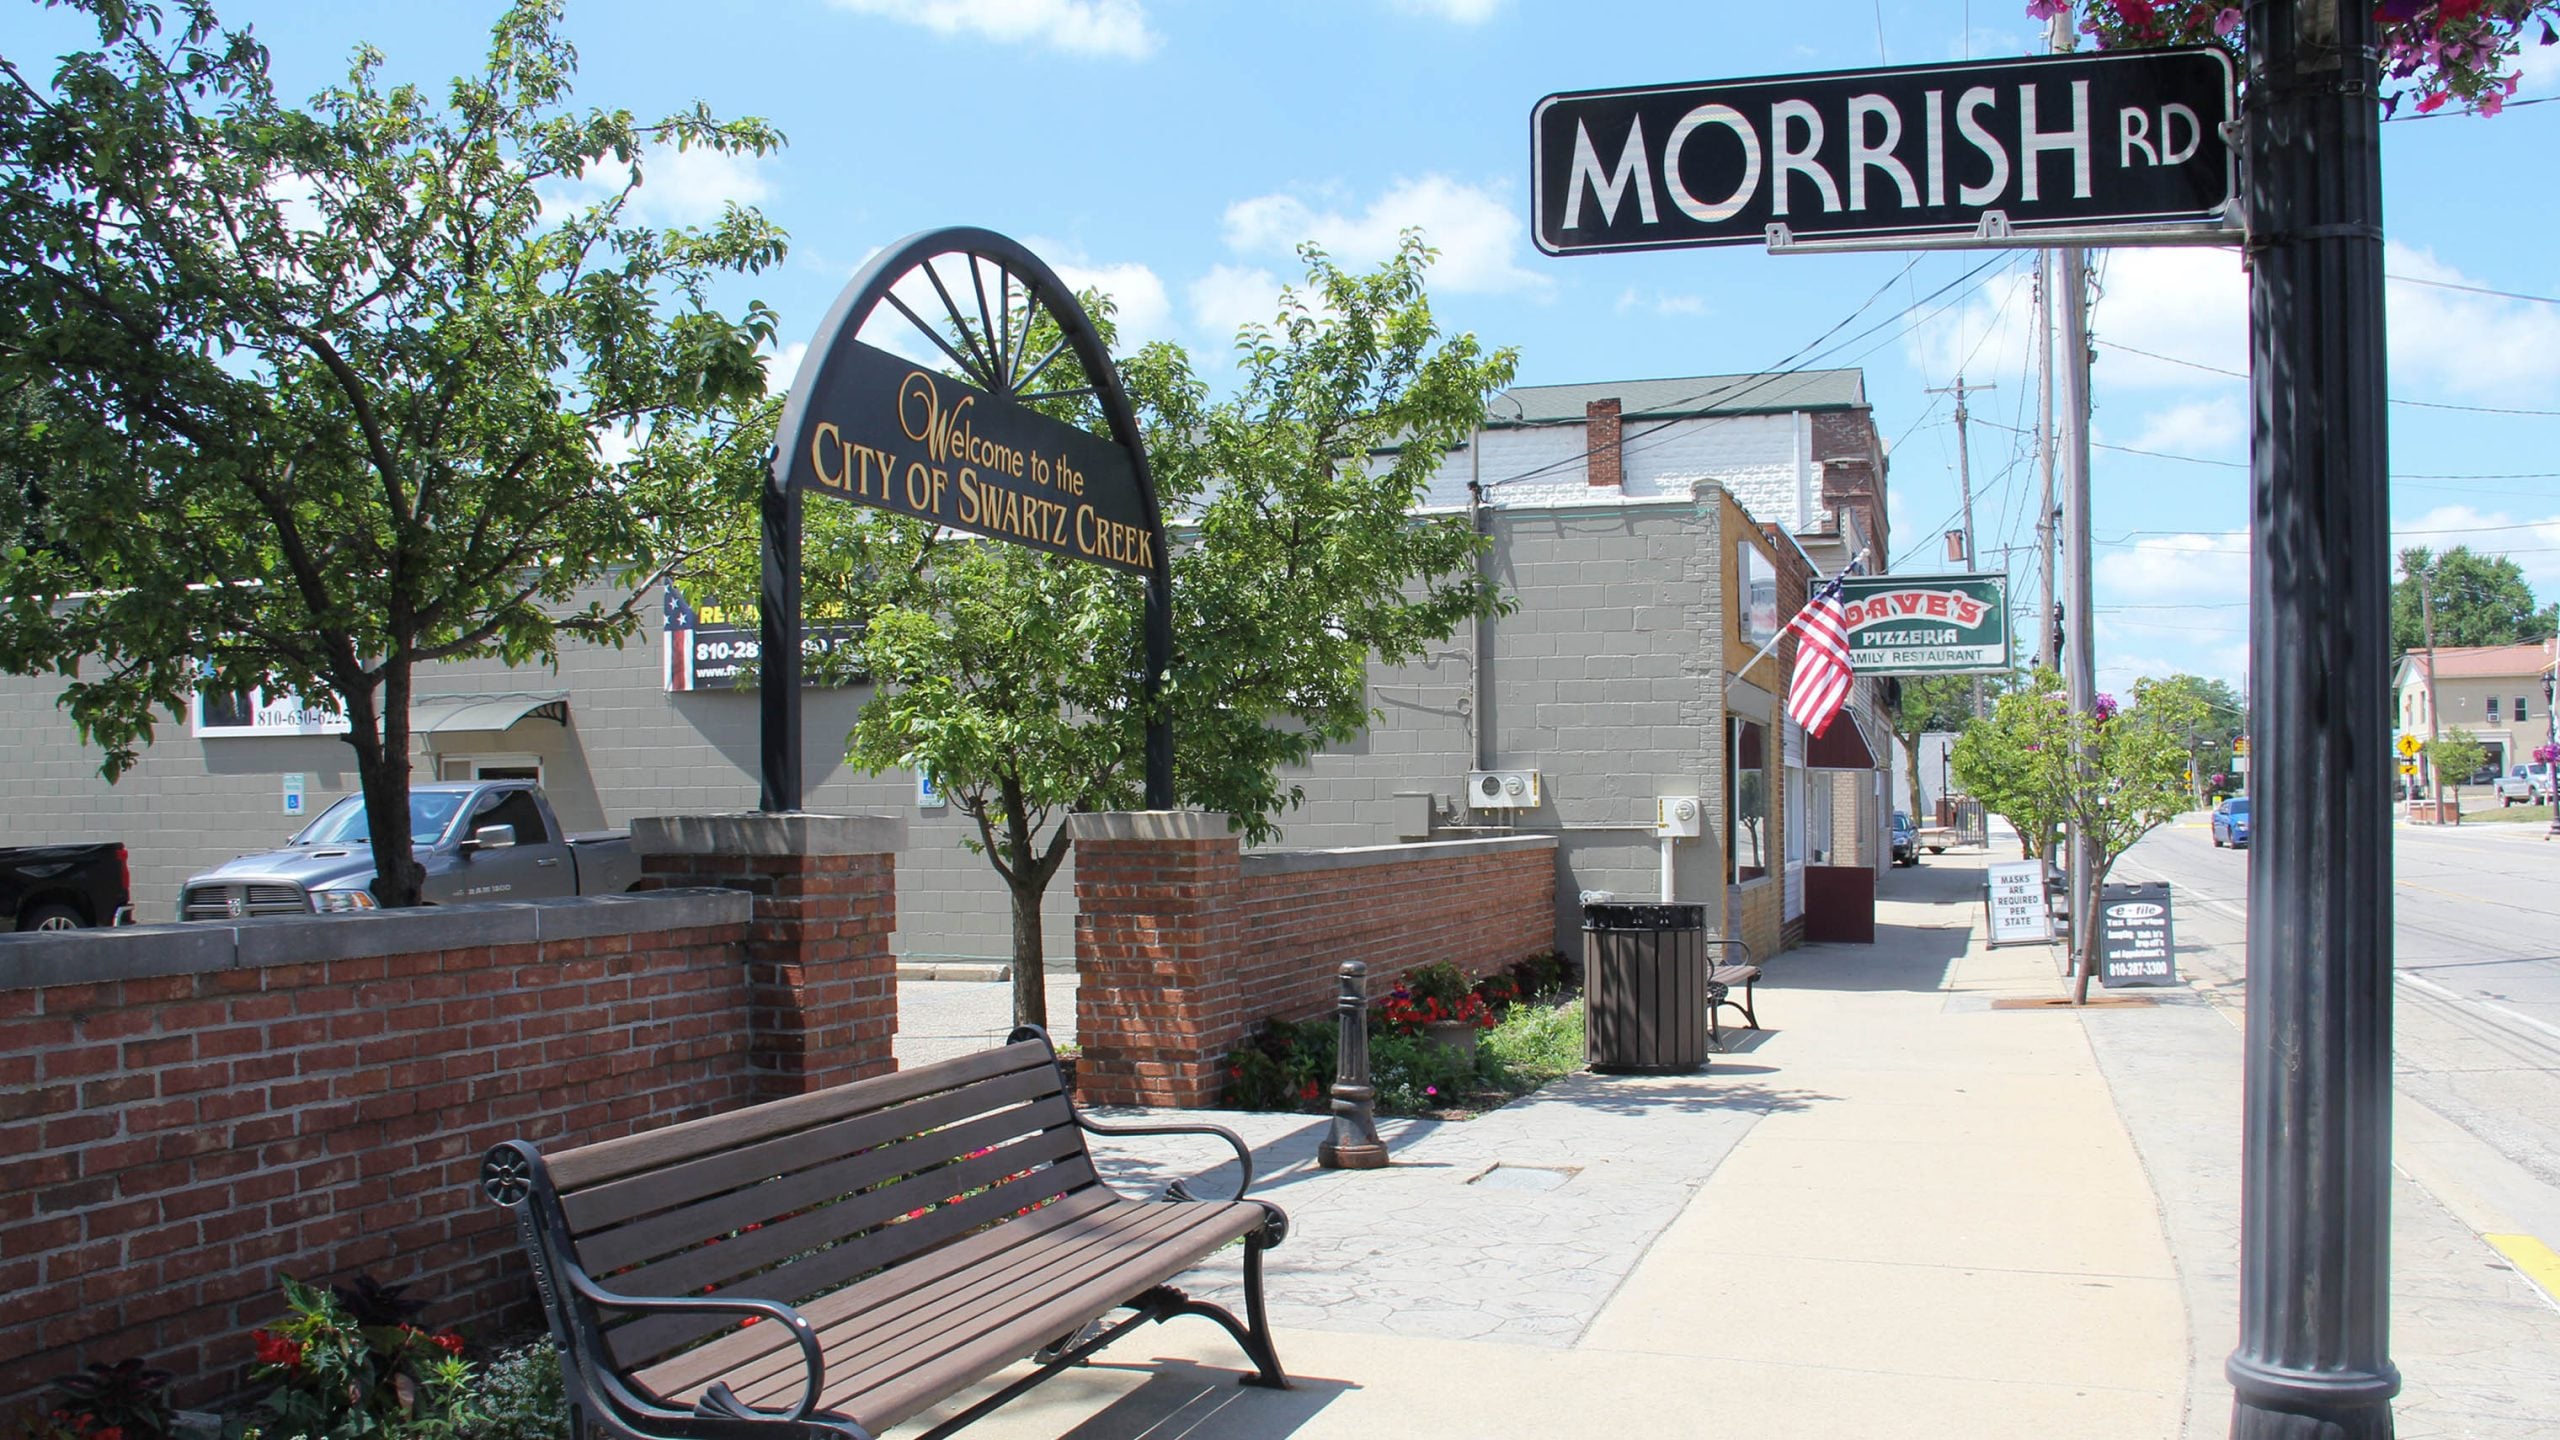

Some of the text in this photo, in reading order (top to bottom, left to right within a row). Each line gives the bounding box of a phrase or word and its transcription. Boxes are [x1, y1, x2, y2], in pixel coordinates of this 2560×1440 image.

[1561, 79, 2201, 230] MORRISH RD
[898, 370, 1085, 497] Welcome to the
[811, 420, 1155, 570] CITY OF SWARTZ CREEK
[1845, 593, 1982, 628] DAVE'S
[1862, 629, 1958, 646] PIZZERIA
[1848, 650, 1984, 664] AMILY RESTAURANT
[2001, 874, 2031, 884] MASKS
[2009, 886, 2024, 894] ARE
[1998, 895, 2039, 905] REQUIRED
[2009, 907, 2027, 915] PER
[2004, 917, 2032, 926] STATE
